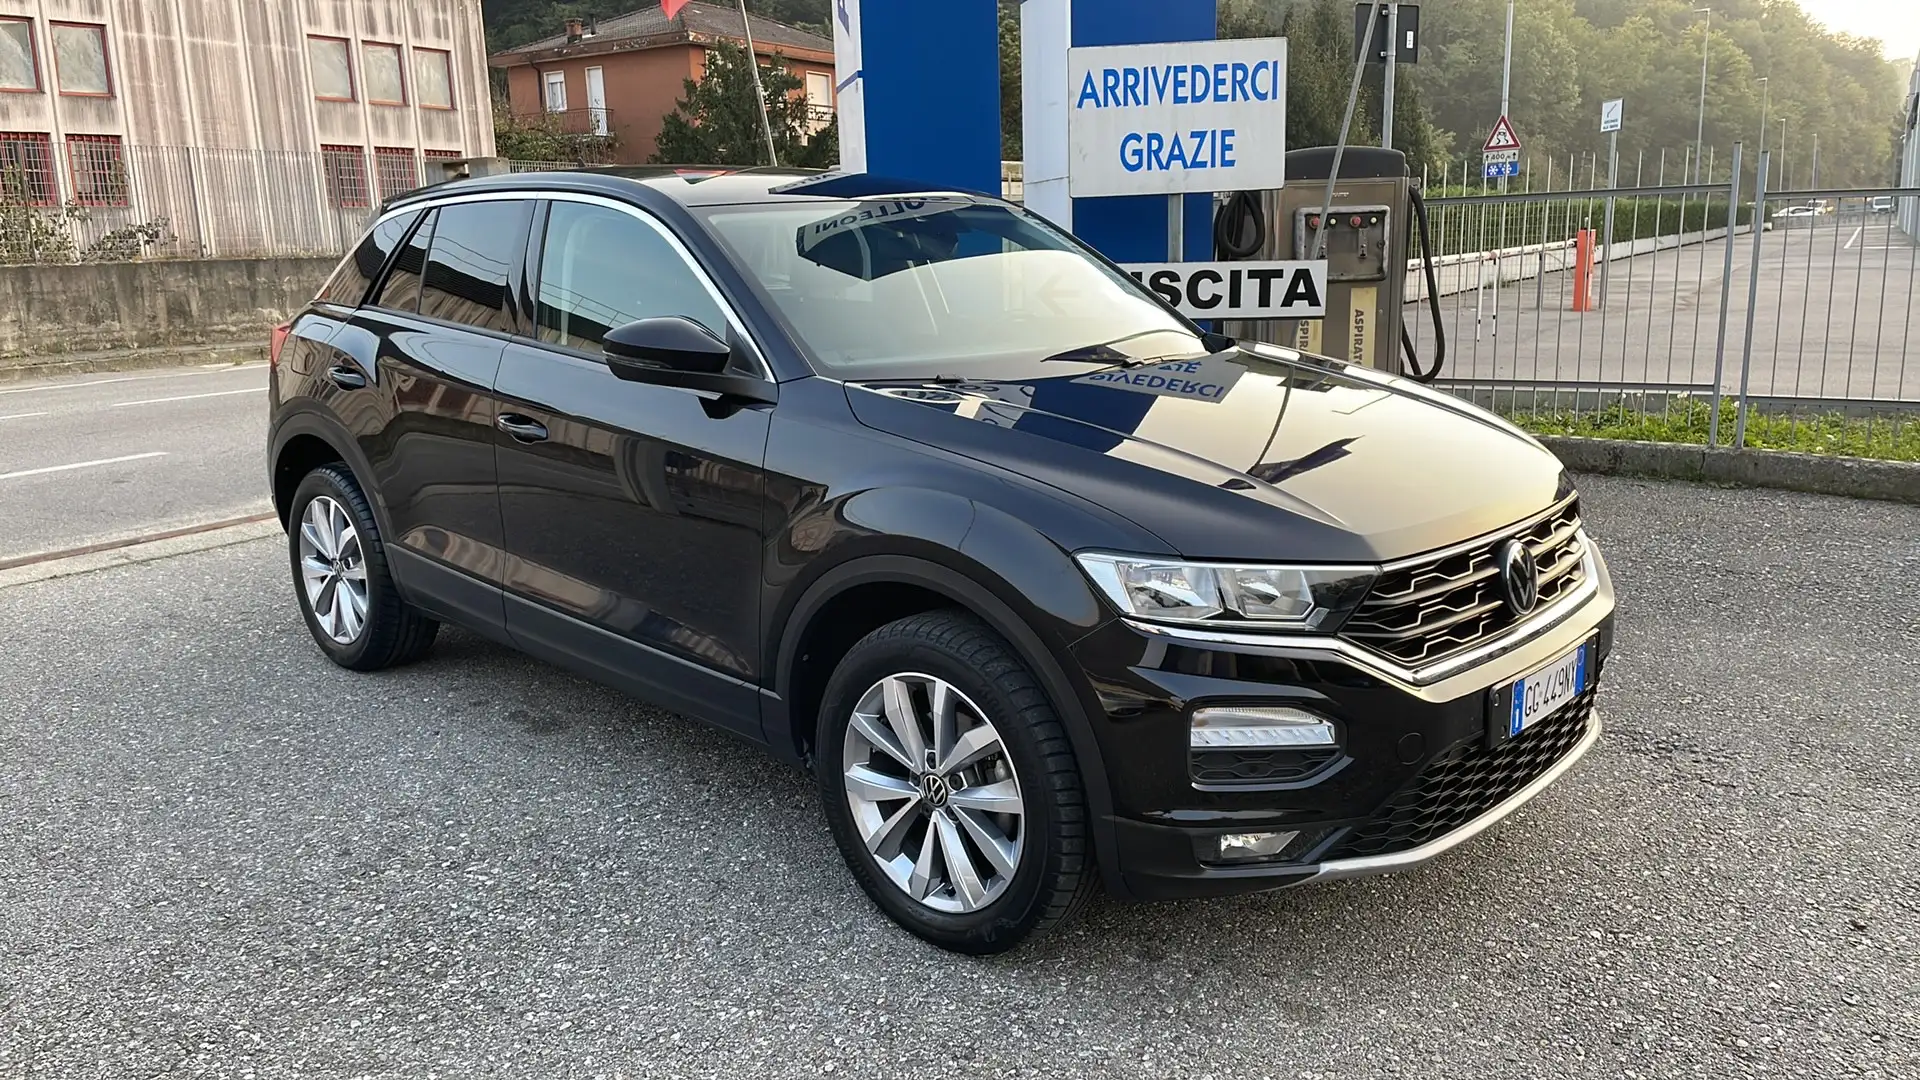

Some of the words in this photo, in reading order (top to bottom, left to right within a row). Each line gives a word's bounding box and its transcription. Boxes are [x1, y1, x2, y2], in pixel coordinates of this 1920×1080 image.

[1076, 60, 1279, 109] ARRIVEDERCI
[1120, 129, 1236, 173] GRAZIE
[1130, 268, 1322, 309] SCITA
[1299, 319, 1310, 351] SPIR
[1525, 681, 1541, 717] GG
[1543, 658, 1577, 706] 449NX
